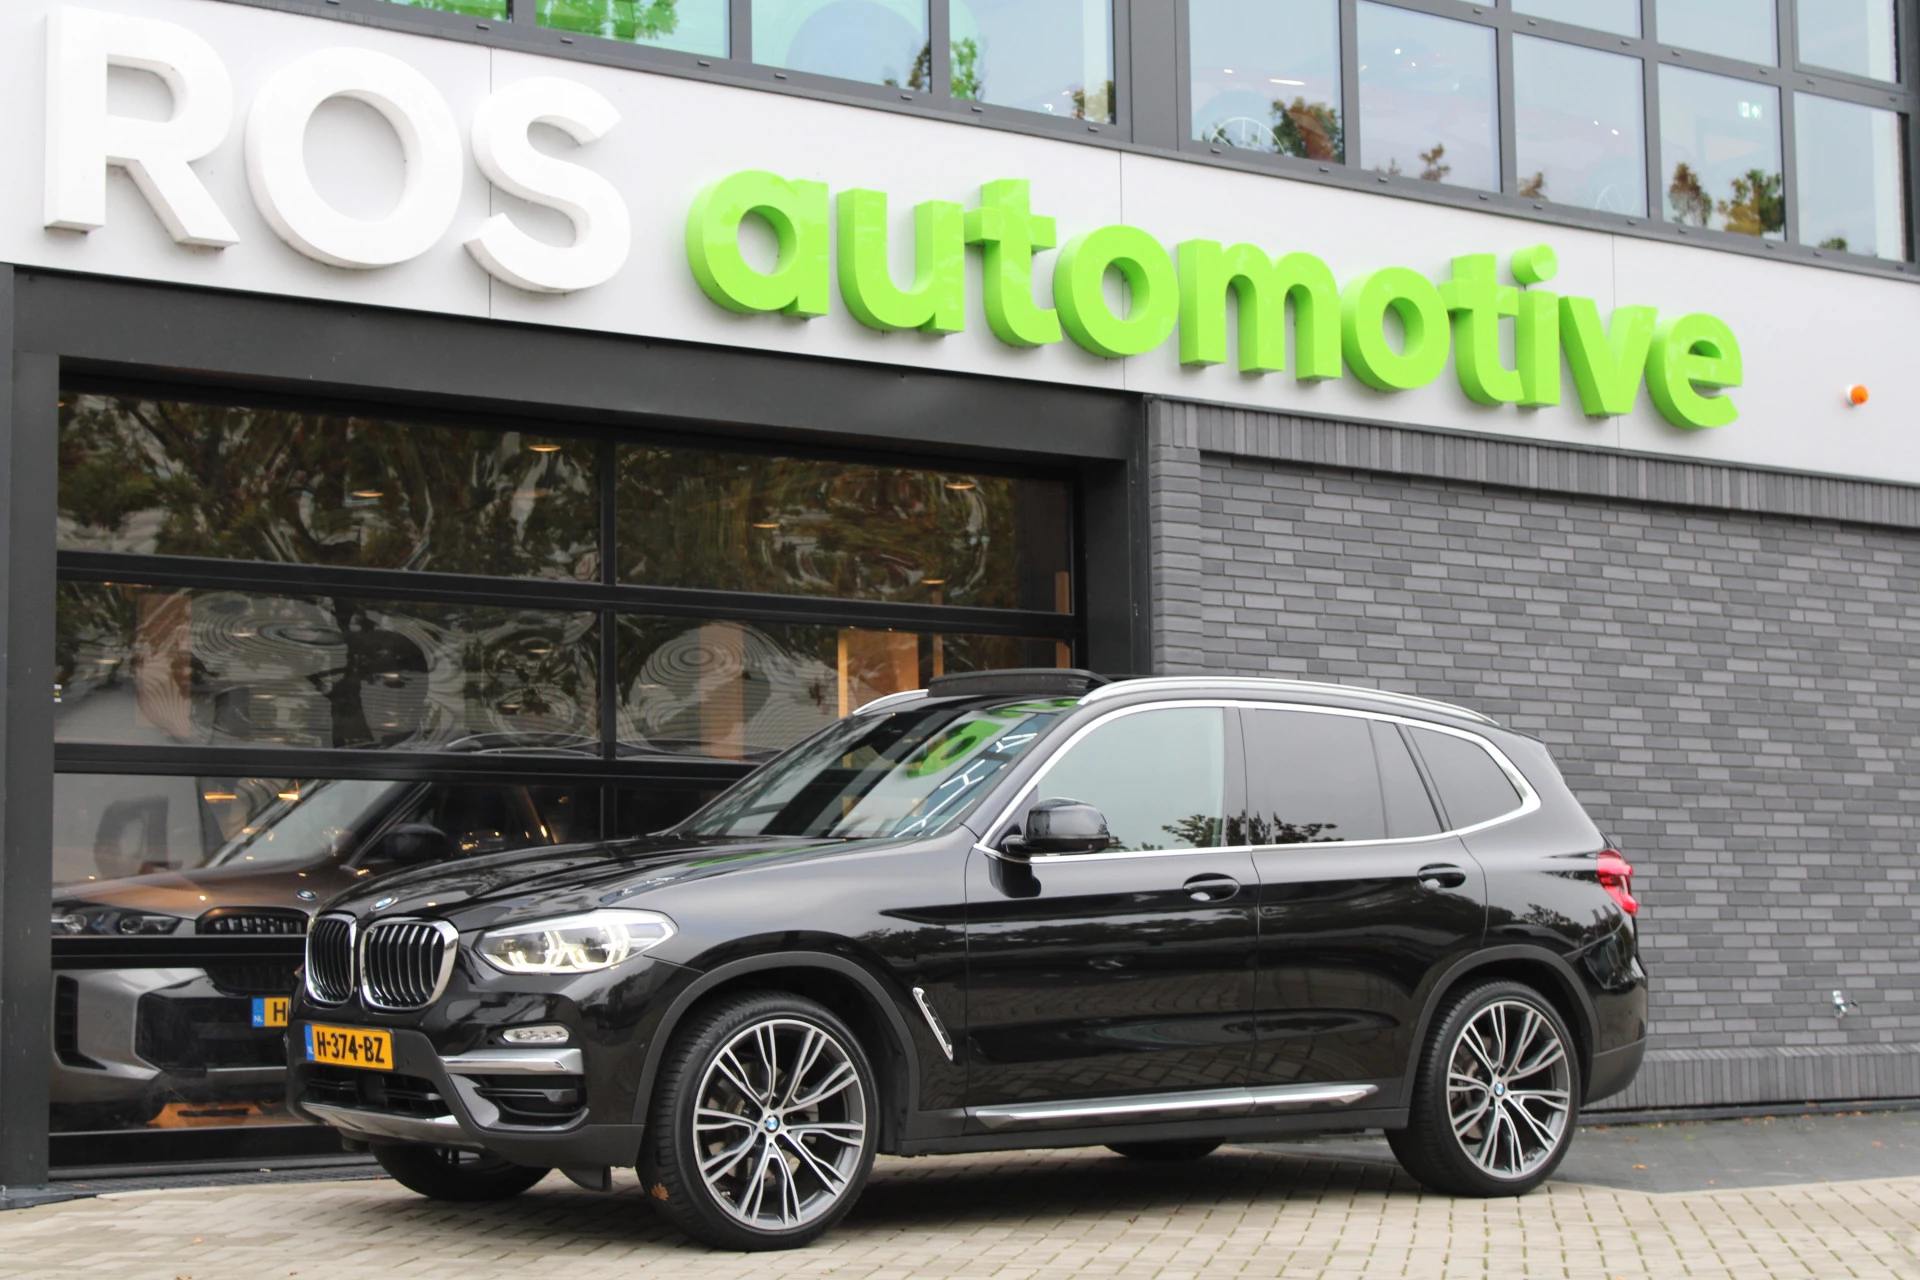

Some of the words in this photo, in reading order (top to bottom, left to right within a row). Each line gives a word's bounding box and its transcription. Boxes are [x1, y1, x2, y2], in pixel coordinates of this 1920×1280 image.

[44, 6, 632, 293] ROS
[686, 169, 1742, 429] automotive
[316, 1031, 385, 1064] H-374-BZ
